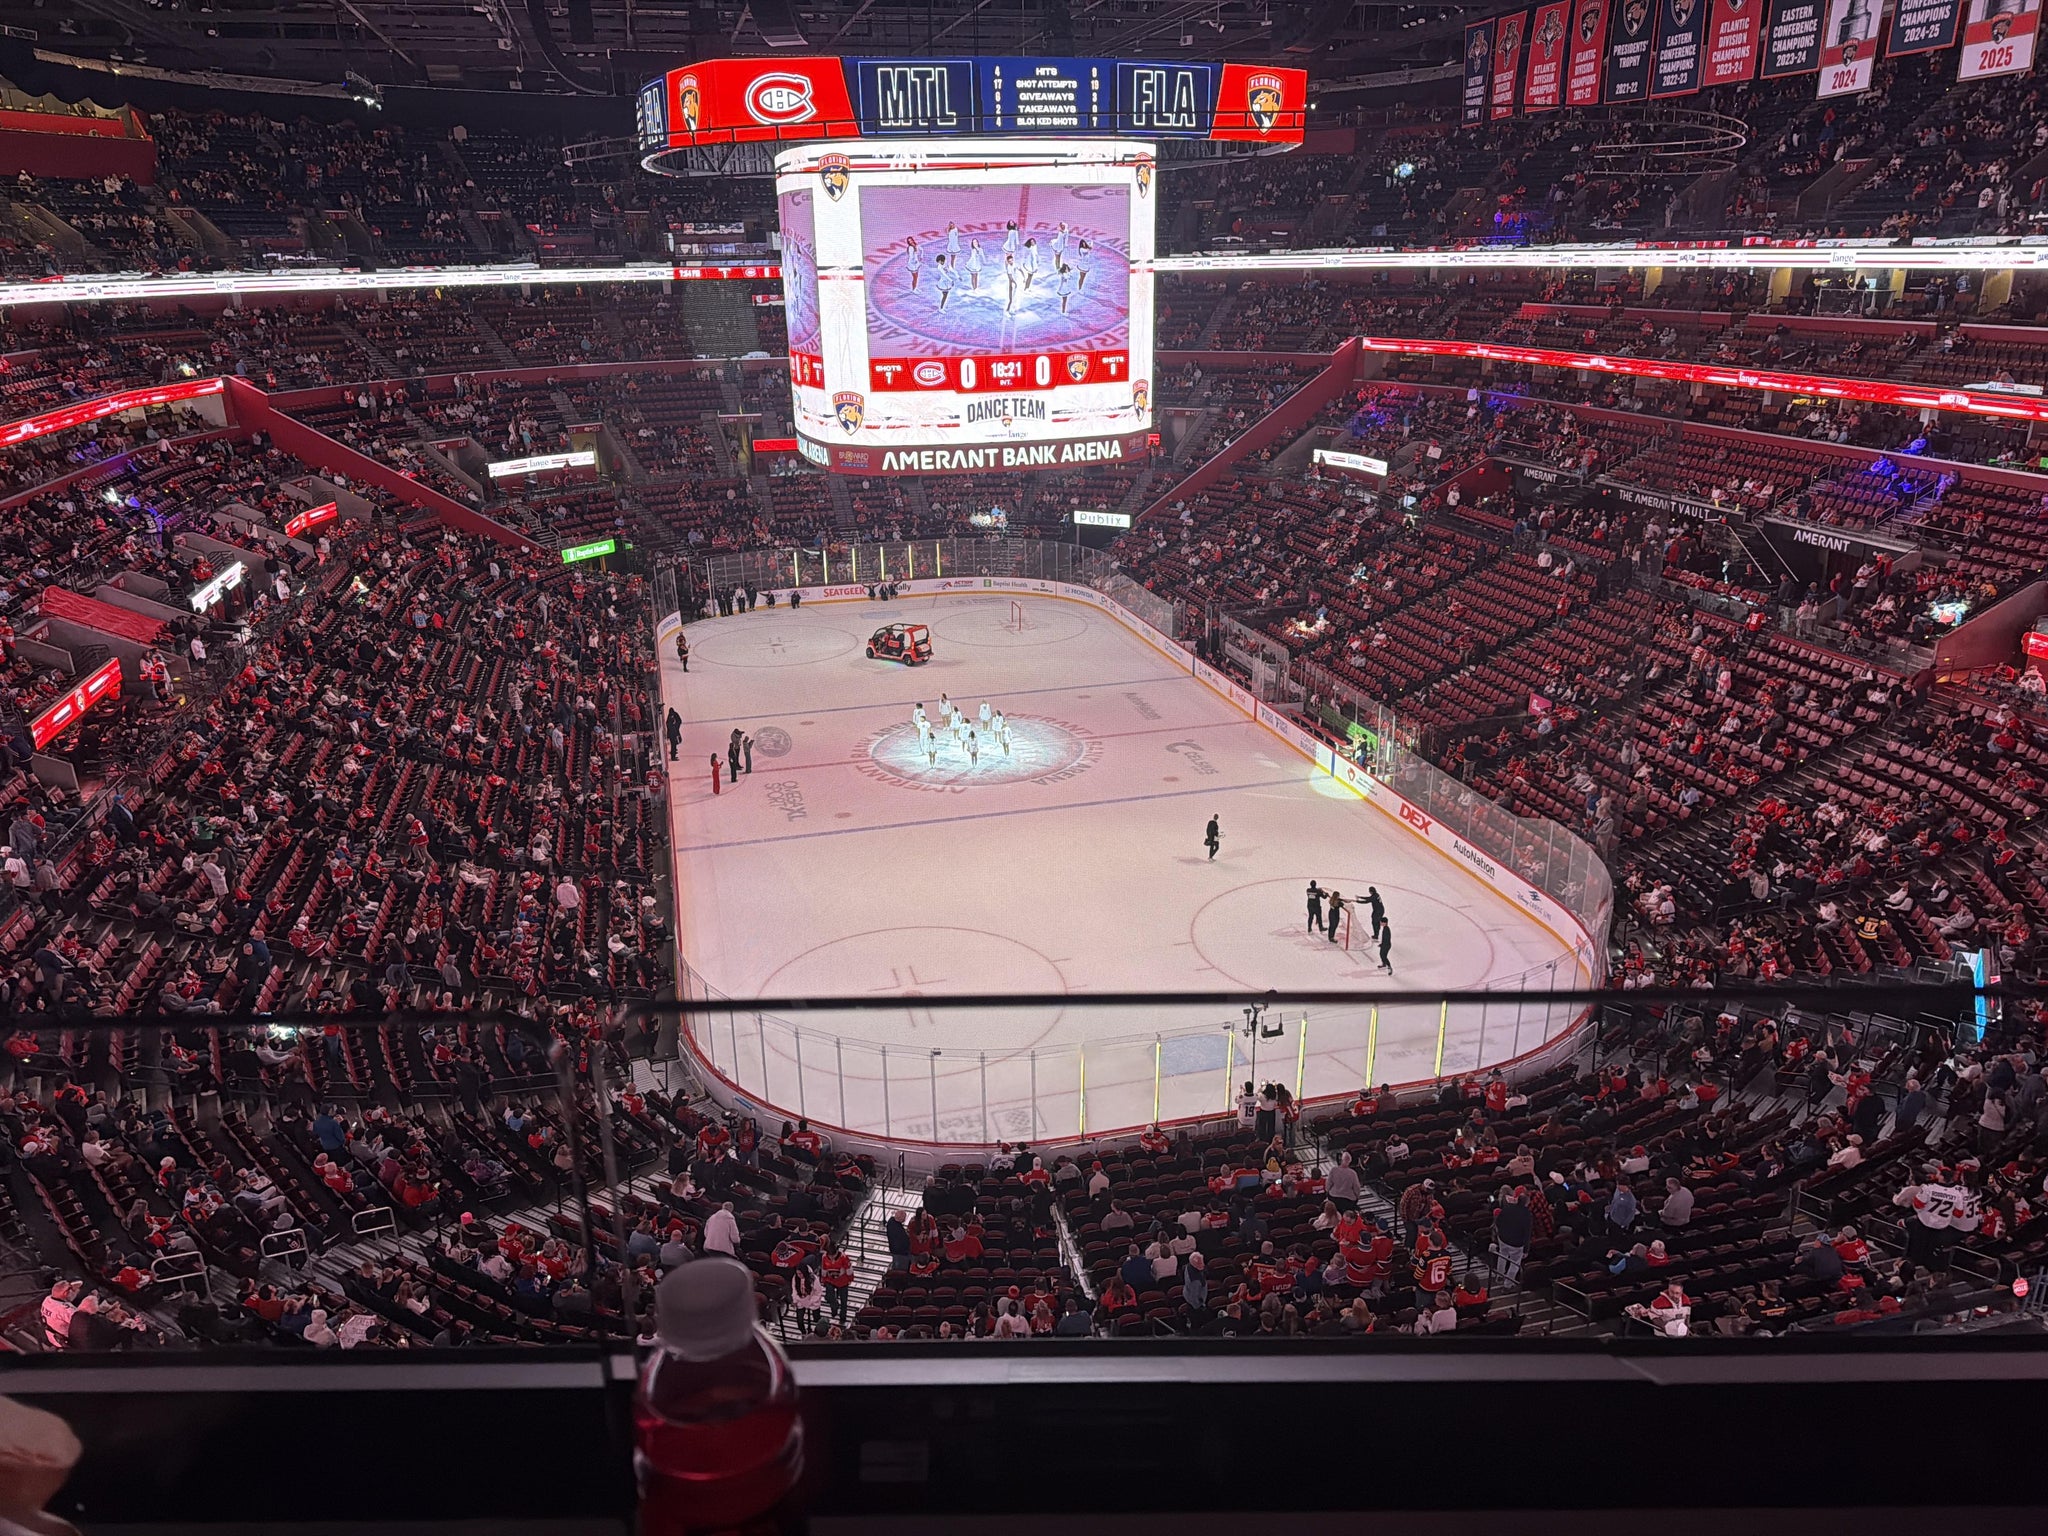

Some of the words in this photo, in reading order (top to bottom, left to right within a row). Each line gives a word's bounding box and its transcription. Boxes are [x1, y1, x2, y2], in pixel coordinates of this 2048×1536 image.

[1781, 5, 1813, 22] EASTERN
[1900, 5, 1951, 27] CHAMPIONS
[1719, 17, 1749, 34] ATLANTIC
[1772, 19, 1818, 38] CONFERENCE
[1904, 23, 1940, 43] 2024-25
[1666, 31, 1693, 47] EASTERN
[1718, 32, 1747, 48] DIVISION
[1772, 35, 1814, 54] CHAMPIONS
[1660, 44, 1696, 61] CONFERENCE
[1712, 46, 1750, 63] CHAMPIONS
[1776, 51, 1807, 67] 2023-24
[1978, 46, 2014, 70] 2025
[994, 65, 1000, 76] 4
[1035, 67, 1057, 76] HITS
[1619, 55, 1641, 69] TROPHY
[1659, 58, 1694, 74] CHAMPIONS
[1715, 60, 1742, 76] 2023-24
[994, 79, 1002, 90] 17
[1016, 80, 1037, 88] SHOT
[1037, 80, 1077, 89] ATTEMPTS
[1662, 73, 1688, 87] 2022-23
[1832, 68, 1857, 90] 2024
[877, 67, 956, 126] MTL
[1019, 92, 1075, 101] GIVEAWAYS
[1615, 81, 1638, 95] 2021-22
[1134, 70, 1196, 126] FLA
[995, 103, 1001, 114] 2
[1018, 104, 1077, 113] TAKEAWAYS
[996, 116, 1001, 127] 4
[1053, 117, 1078, 126] SHOTS
[1092, 116, 1098, 127] 7
[1101, 356, 1124, 364] SHOTS
[957, 358, 976, 389] 0
[1035, 355, 1050, 385] 0
[967, 398, 1009, 423] DANCE
[1012, 398, 1045, 420] TEAM
[882, 448, 999, 471] AMERANT
[1003, 444, 1057, 467] BANK
[1061, 439, 1123, 463] ARENA
[1524, 468, 1557, 484] AMERANT
[1619, 489, 1633, 502] THE
[1634, 494, 1675, 513] AMERANT
[1678, 503, 1711, 520] VAULT
[1080, 511, 1121, 526] Publix
[1793, 529, 1851, 552] AMERANT
[823, 586, 866, 597] SEATGEEK
[1070, 588, 1094, 600] HONDA
[1399, 802, 1433, 836] DEX
[1453, 839, 1496, 877] AutoNation
[1928, 1198, 1954, 1218] 72
[1430, 1265, 1447, 1284] 16
